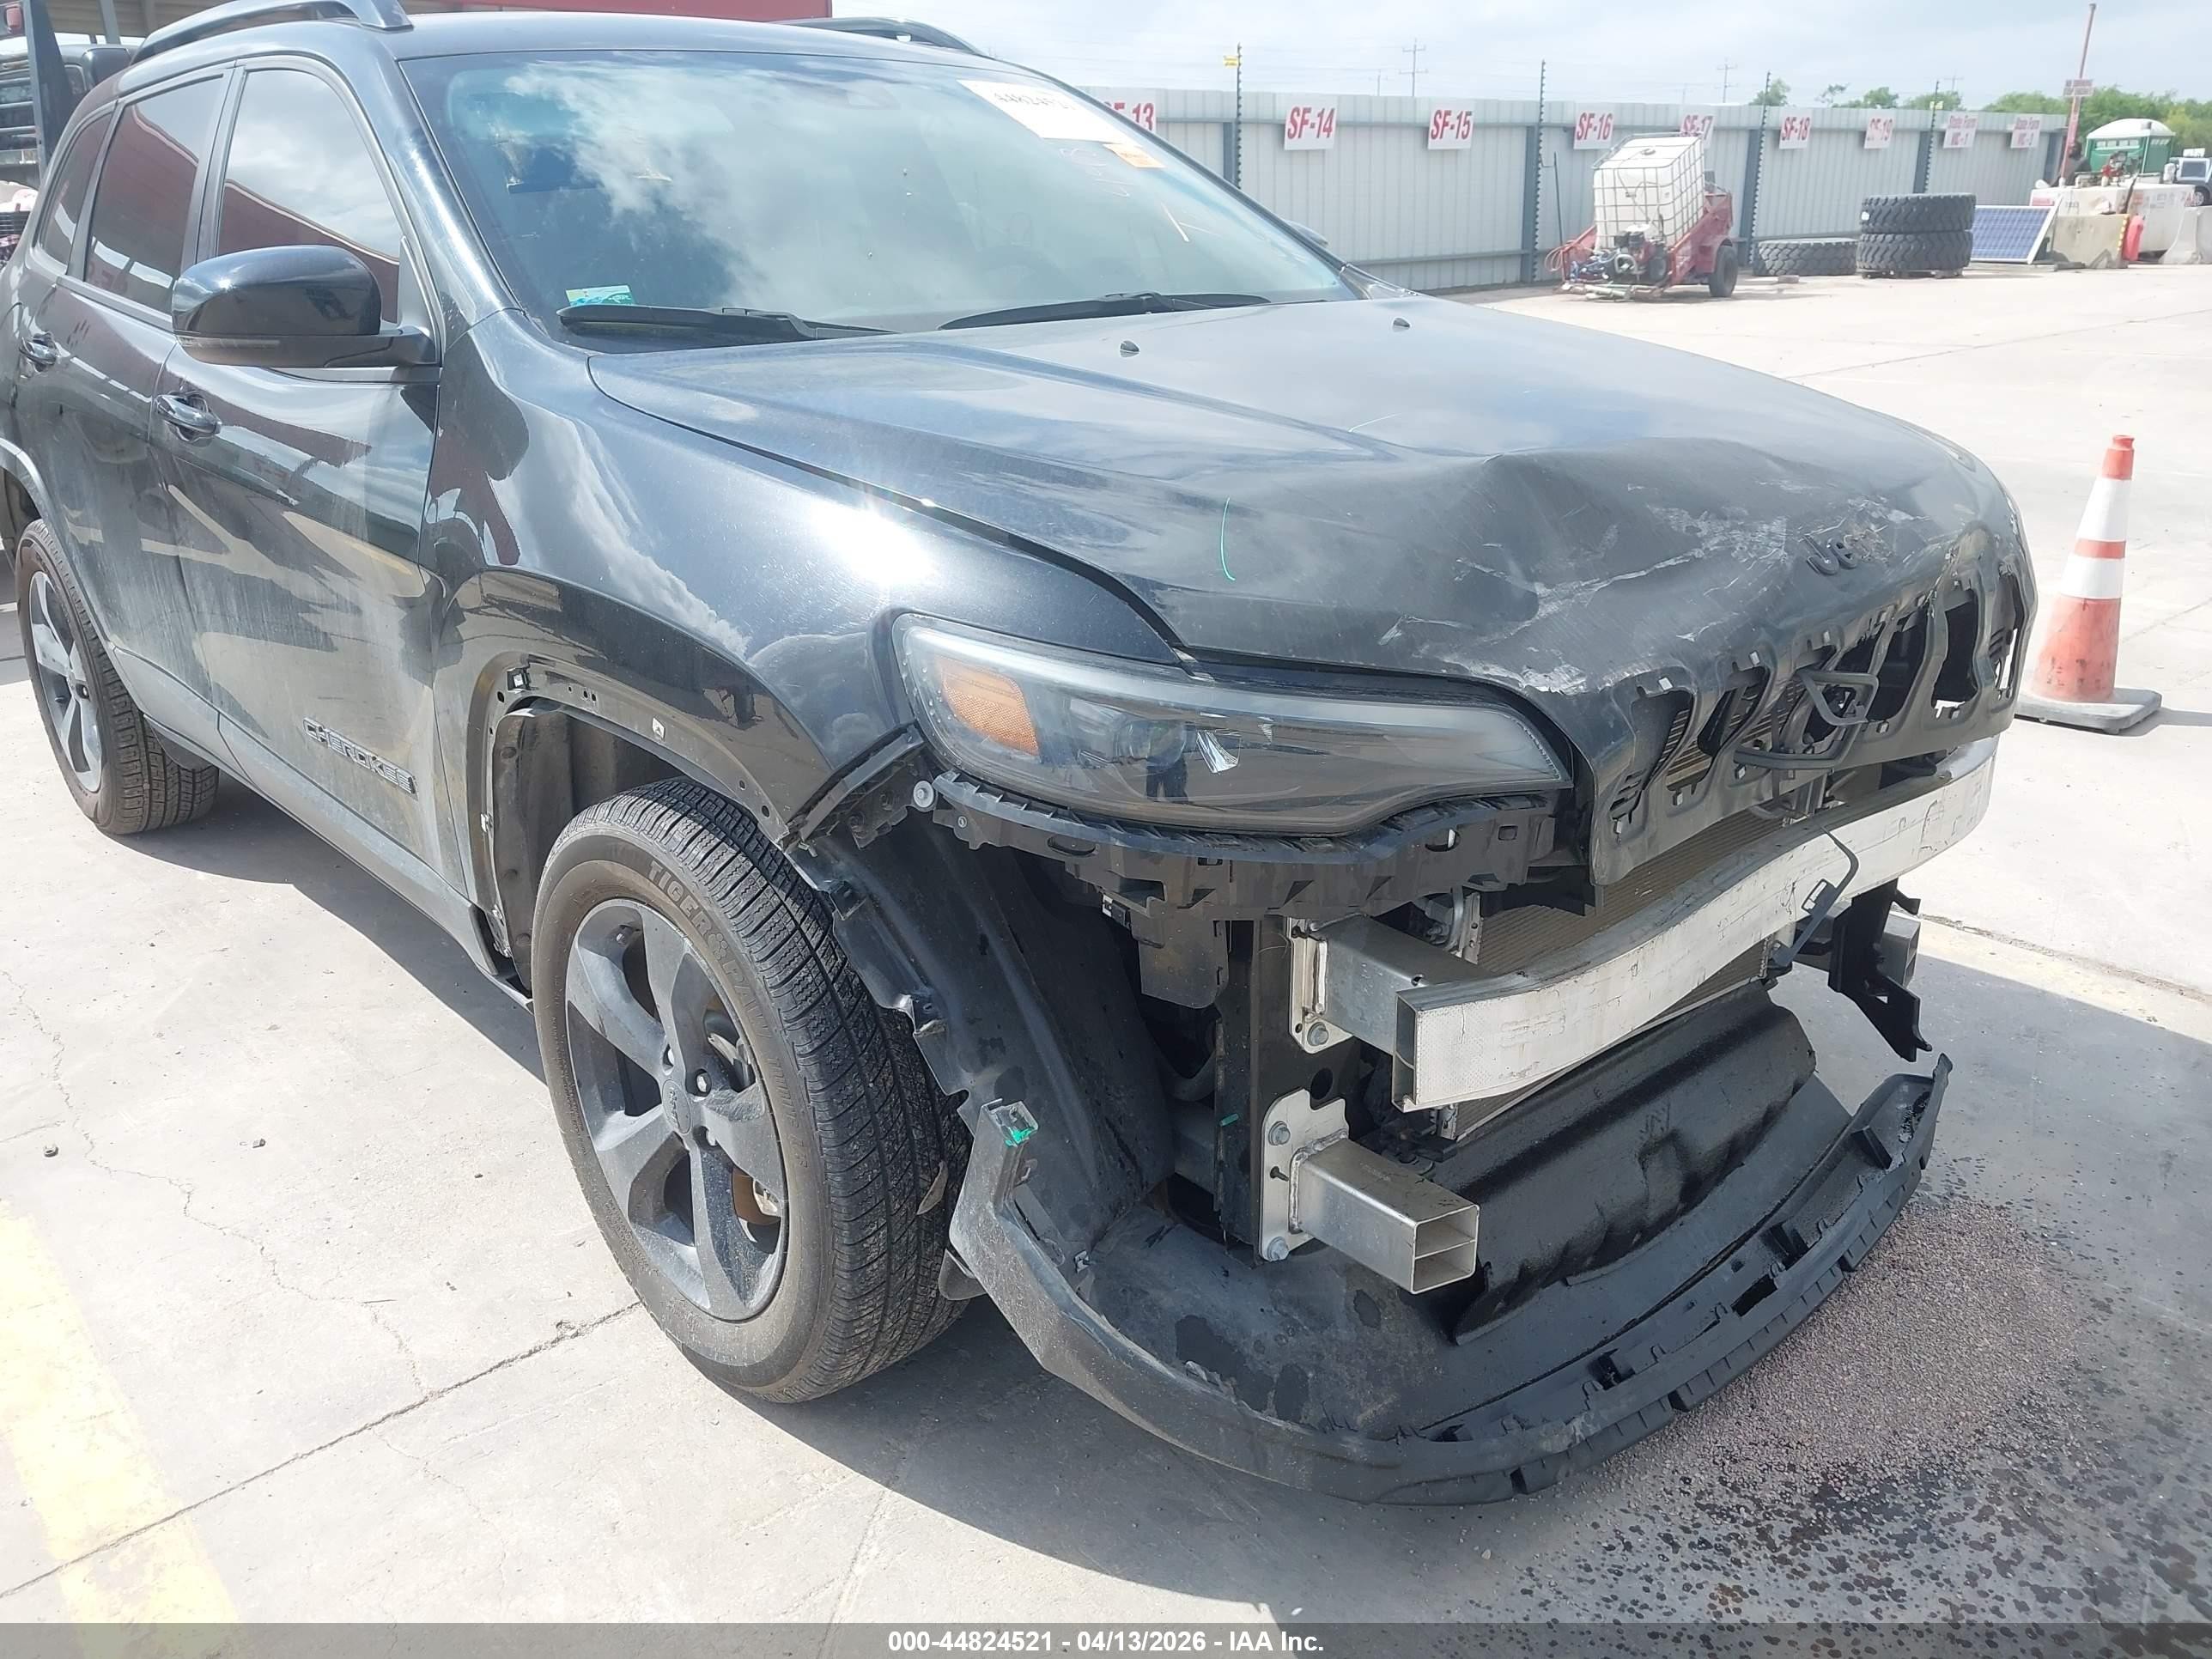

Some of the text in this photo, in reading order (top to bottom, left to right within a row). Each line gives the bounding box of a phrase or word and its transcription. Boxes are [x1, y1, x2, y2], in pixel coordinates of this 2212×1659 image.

[1287, 106, 1335, 139] SF-14
[1431, 109, 1472, 140] SF-15
[1577, 112, 1613, 141] SF-16
[1782, 116, 1810, 141] SF-18
[303, 717, 416, 795] CHEROKEE
[648, 860, 773, 1038] TIGER PAW
